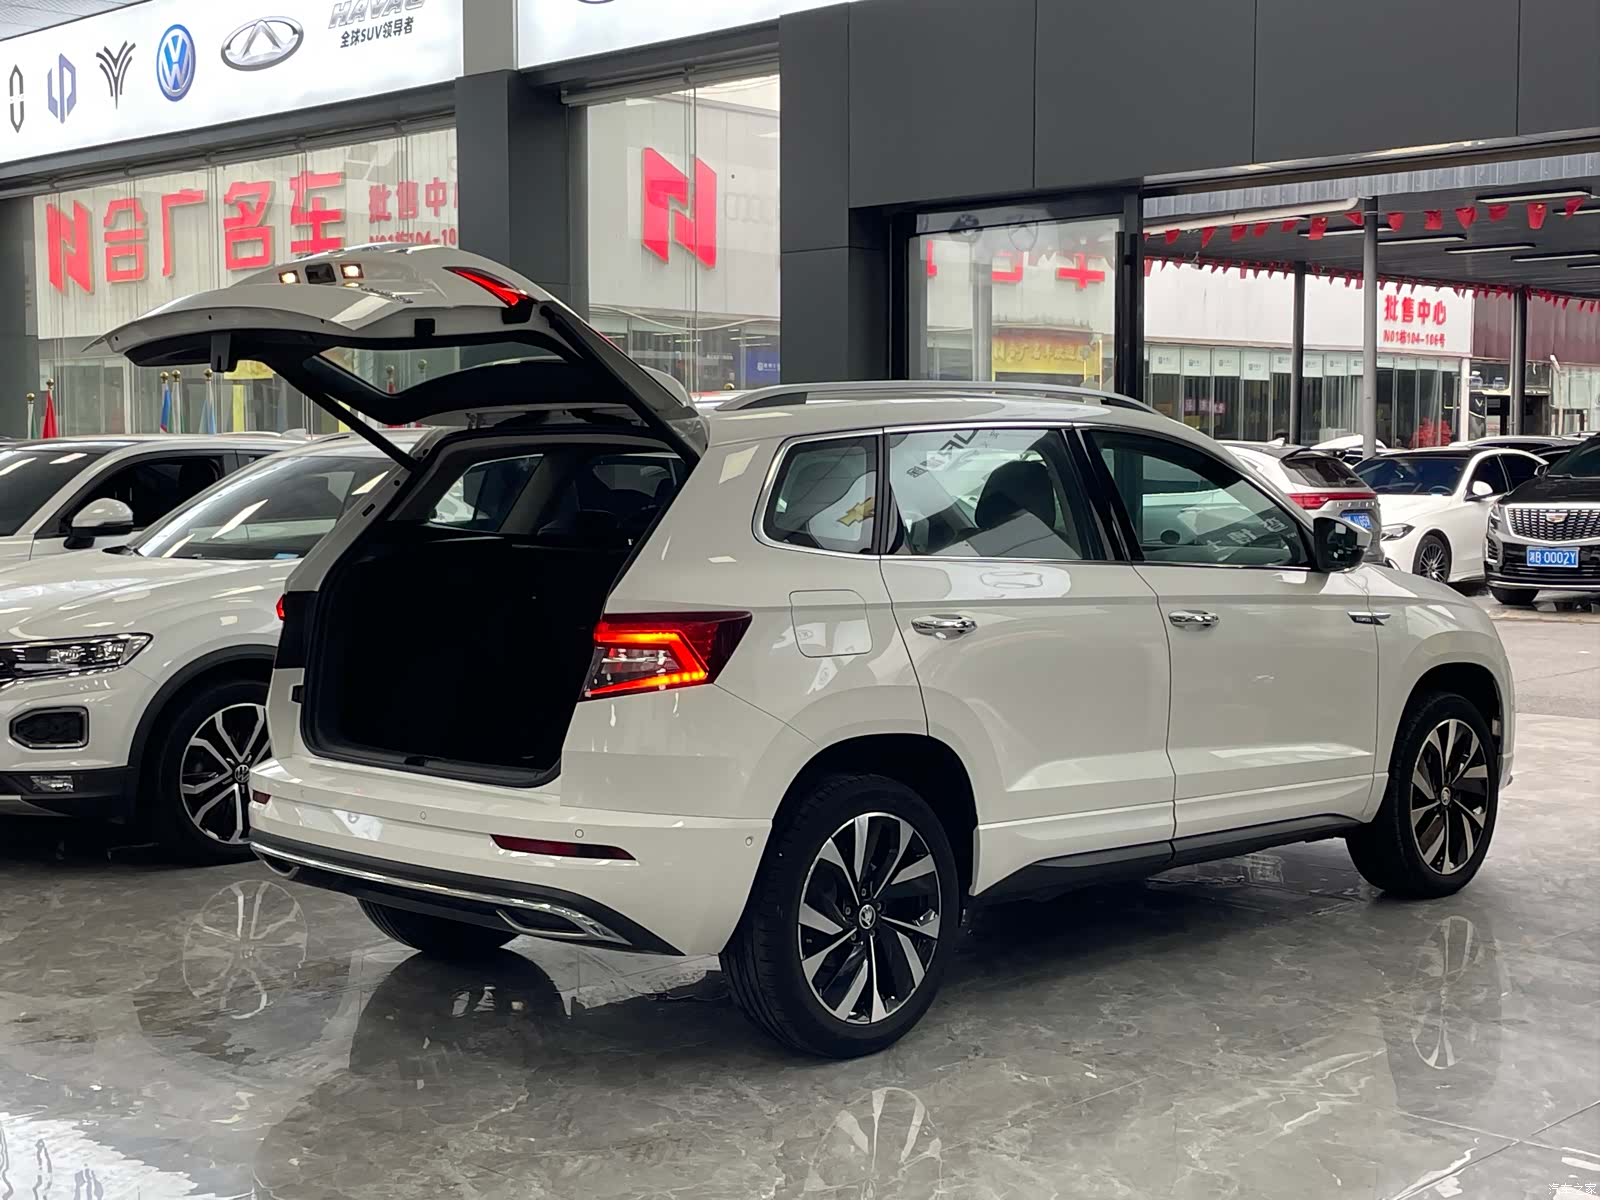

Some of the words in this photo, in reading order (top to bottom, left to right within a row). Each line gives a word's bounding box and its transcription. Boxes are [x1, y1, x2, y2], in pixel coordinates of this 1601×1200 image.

[340, 16, 414, 48] 全球SUV领导者
[369, 177, 459, 224] 批售中
[103, 171, 346, 283] 合广名车
[1384, 295, 1447, 326] 批售中心
